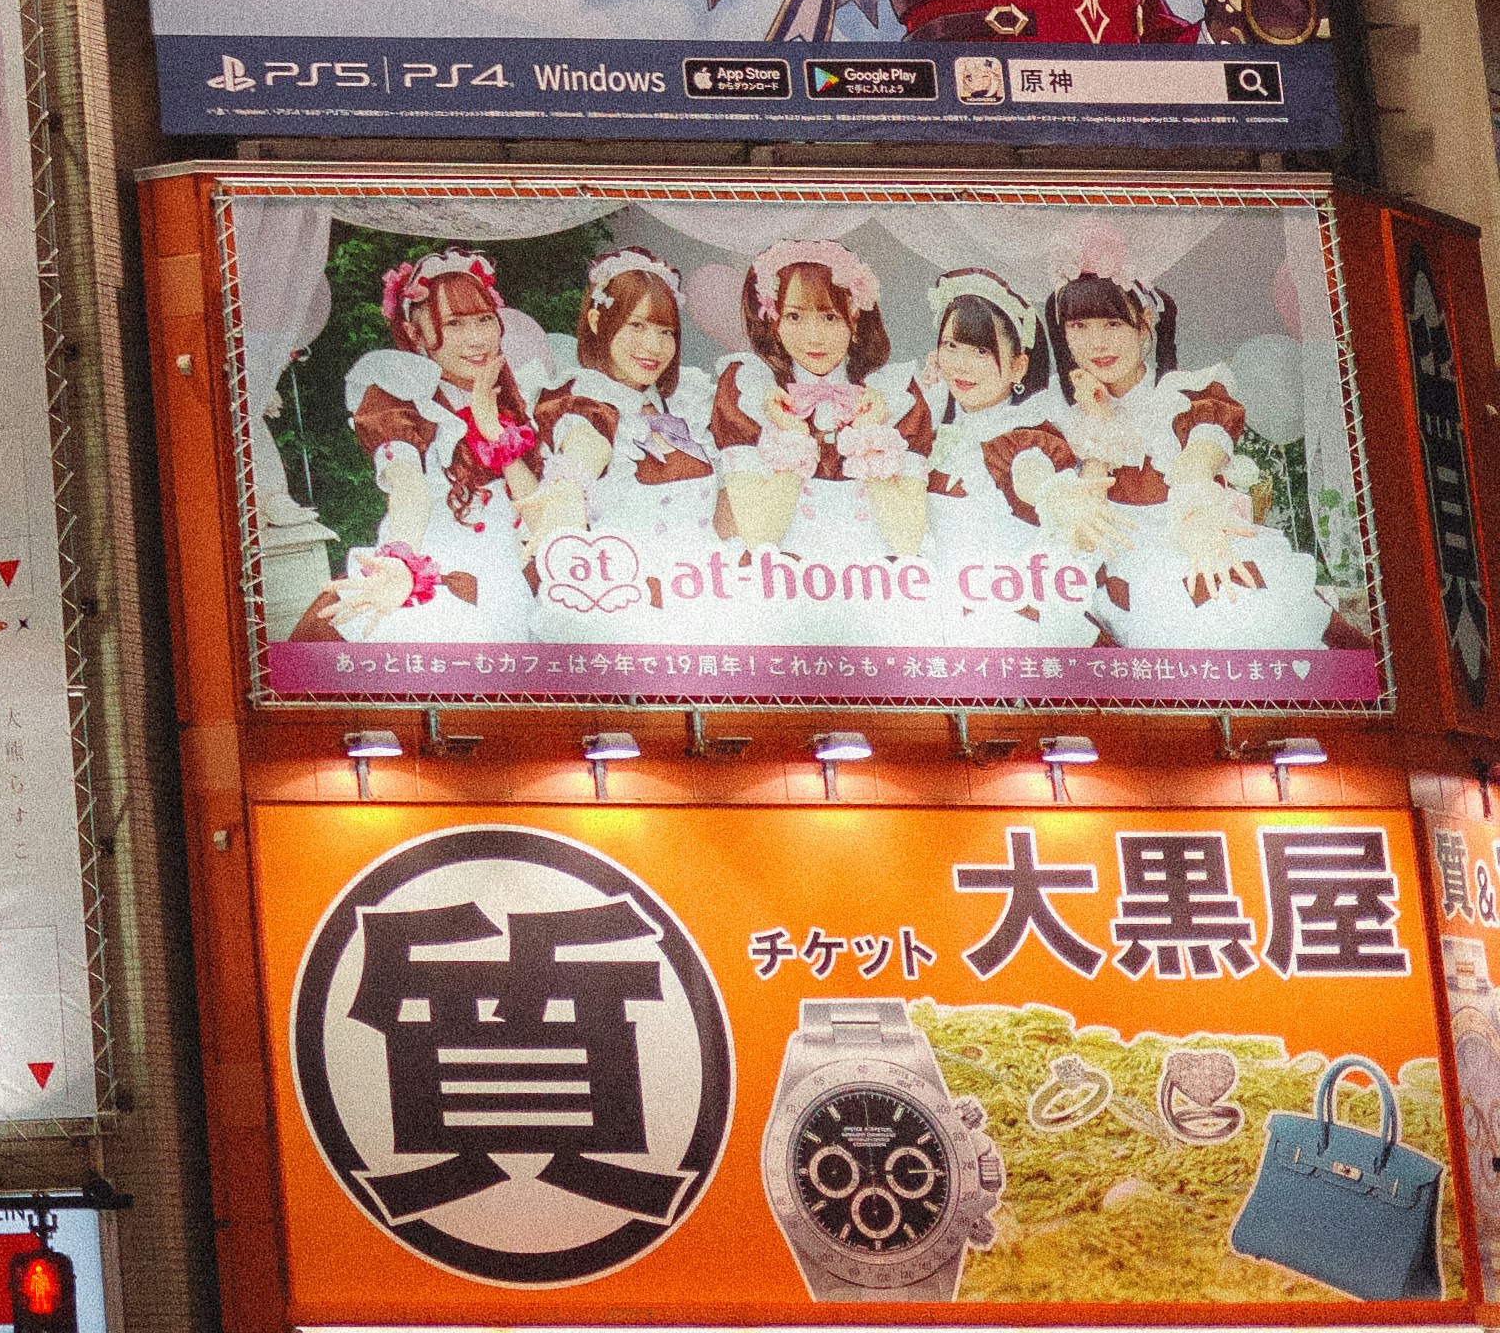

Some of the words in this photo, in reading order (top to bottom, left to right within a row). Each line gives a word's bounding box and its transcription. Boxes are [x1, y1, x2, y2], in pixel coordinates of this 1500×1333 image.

[265, 62, 373, 87] PS5
[403, 63, 509, 88] PS4
[533, 64, 666, 94] Windows
[718, 67, 744, 82] App
[748, 66, 780, 80] Store
[718, 81, 780, 91] からダウンロード
[845, 67, 888, 84] Google
[891, 67, 917, 84] Play
[845, 84, 905, 95] で手に入れよう
[1021, 69, 1073, 94] 原神
[570, 549, 611, 582] at
[672, 551, 930, 601] at-home
[959, 553, 1088, 604] cafe
[954, 825, 1411, 980] 大黒屋
[748, 923, 936, 983] チケット
[347, 896, 699, 1225] 質
